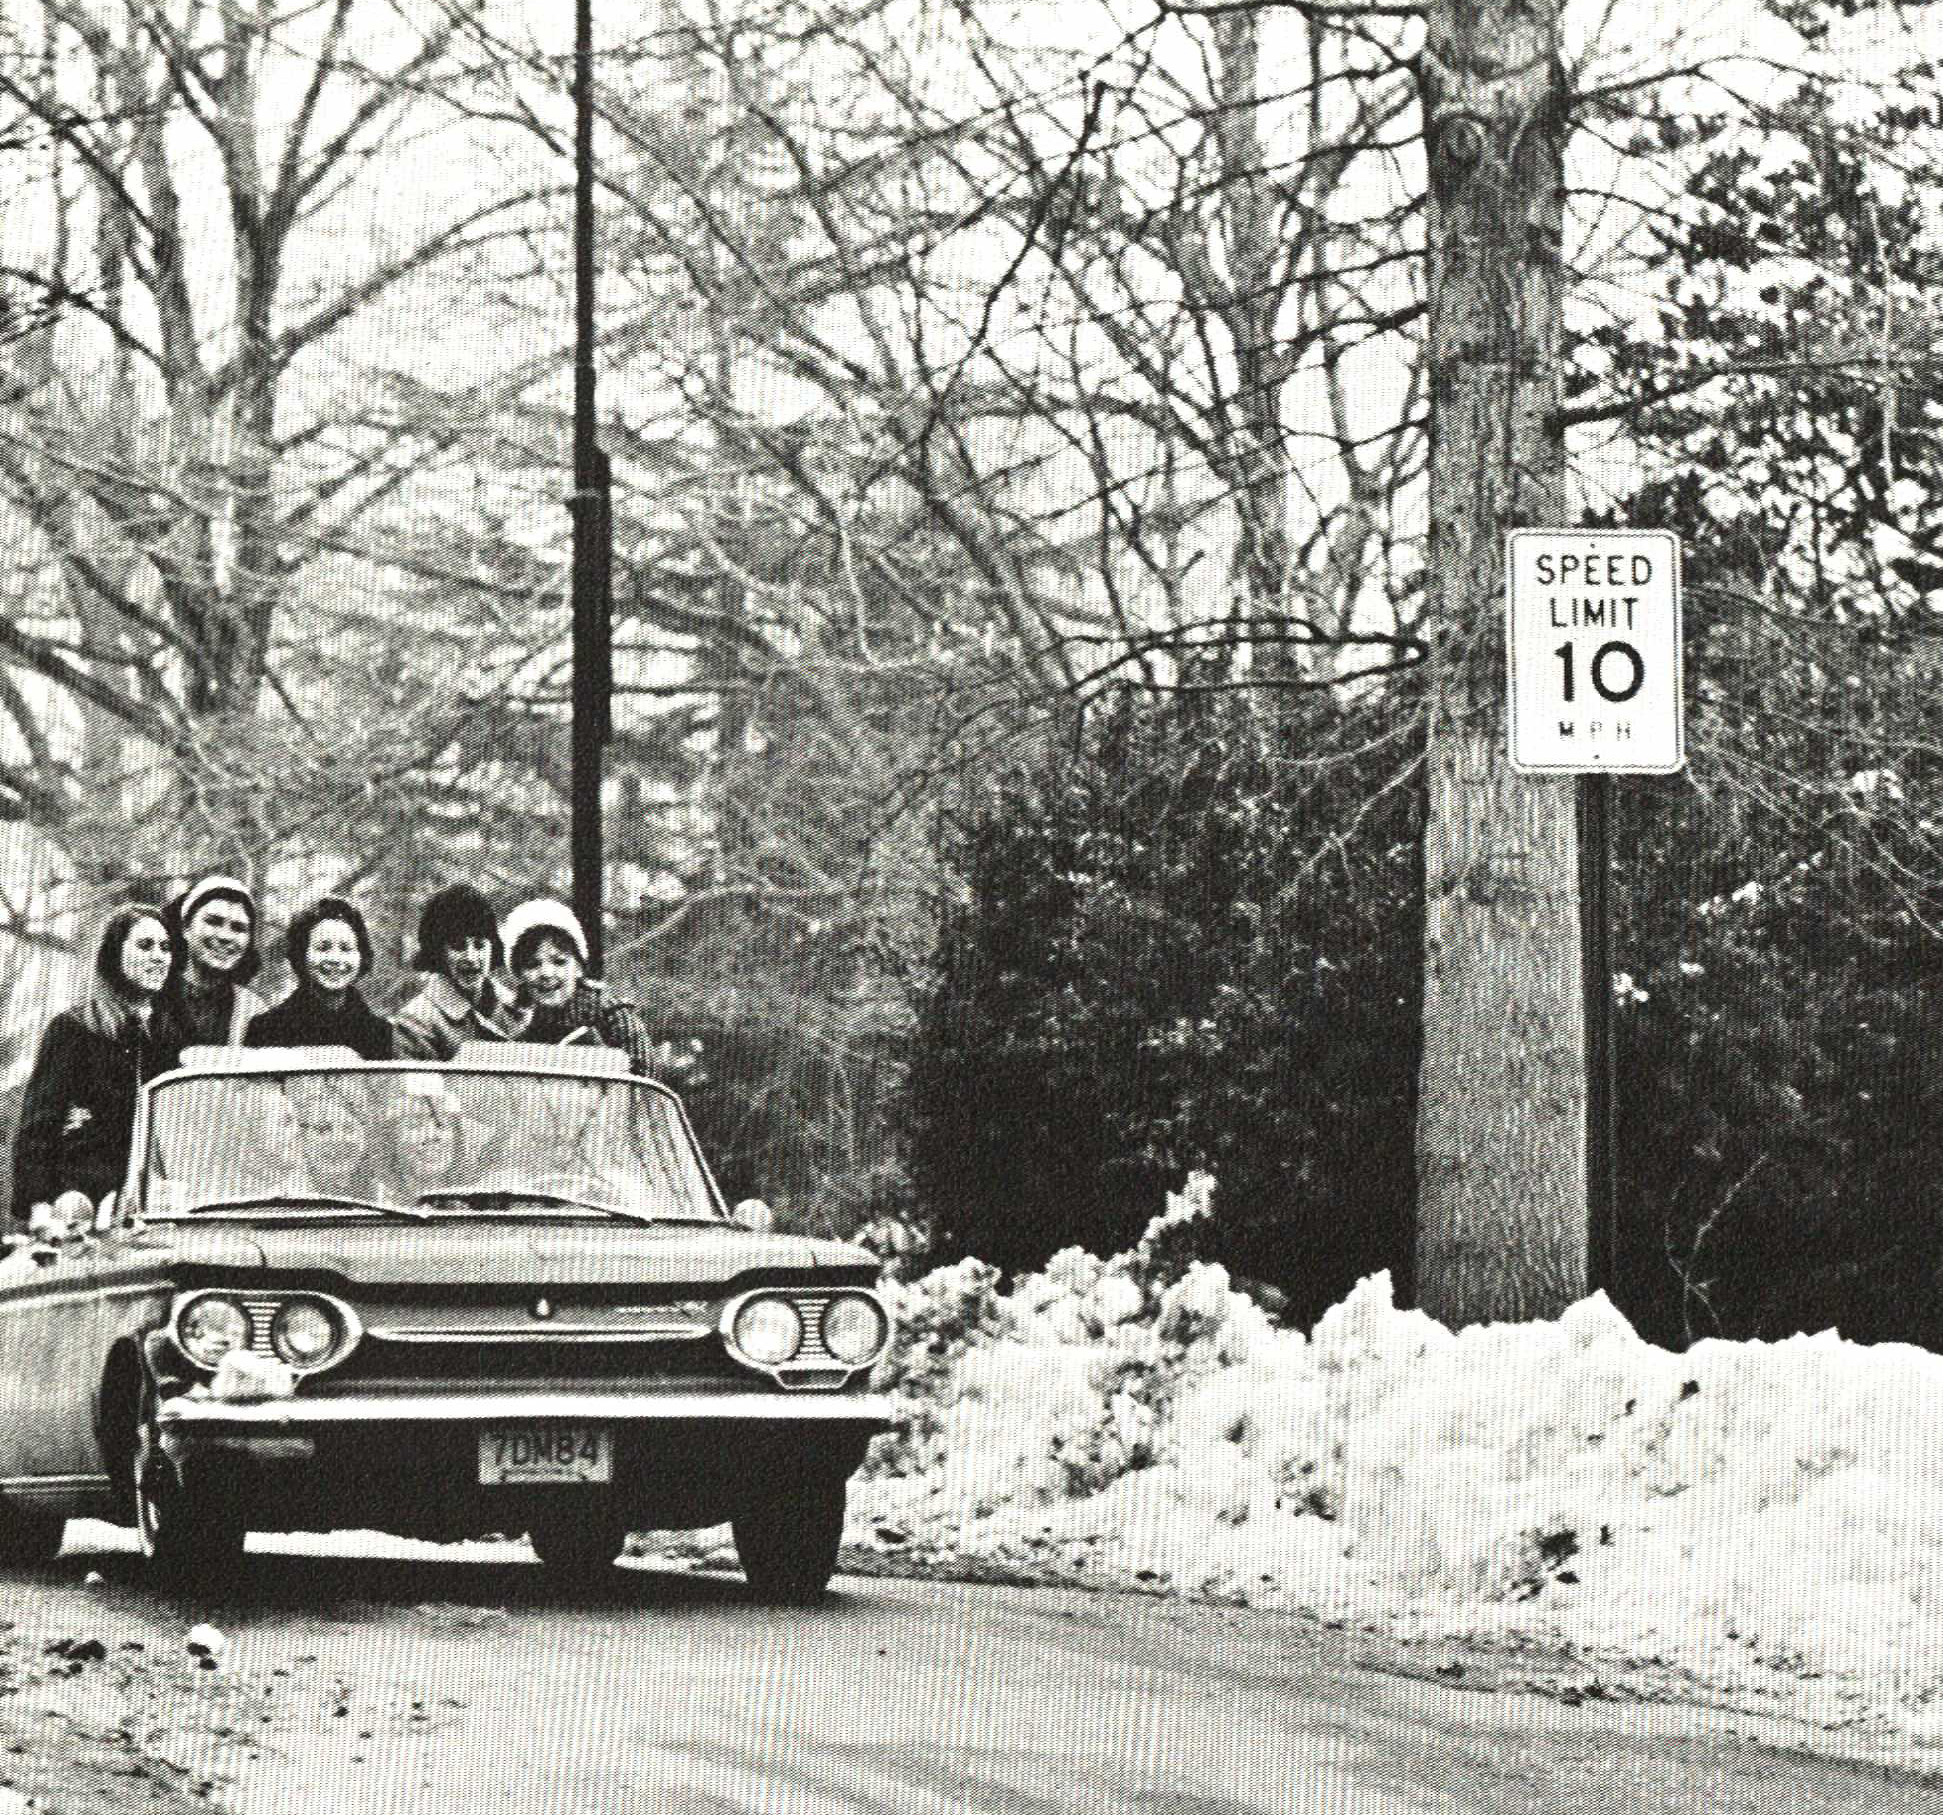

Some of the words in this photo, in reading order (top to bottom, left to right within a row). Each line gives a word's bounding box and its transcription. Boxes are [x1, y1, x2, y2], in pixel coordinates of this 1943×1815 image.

[1536, 554, 1652, 586] SPEED
[1550, 597, 1638, 630] LIMIT
[1554, 640, 1645, 703] 10
